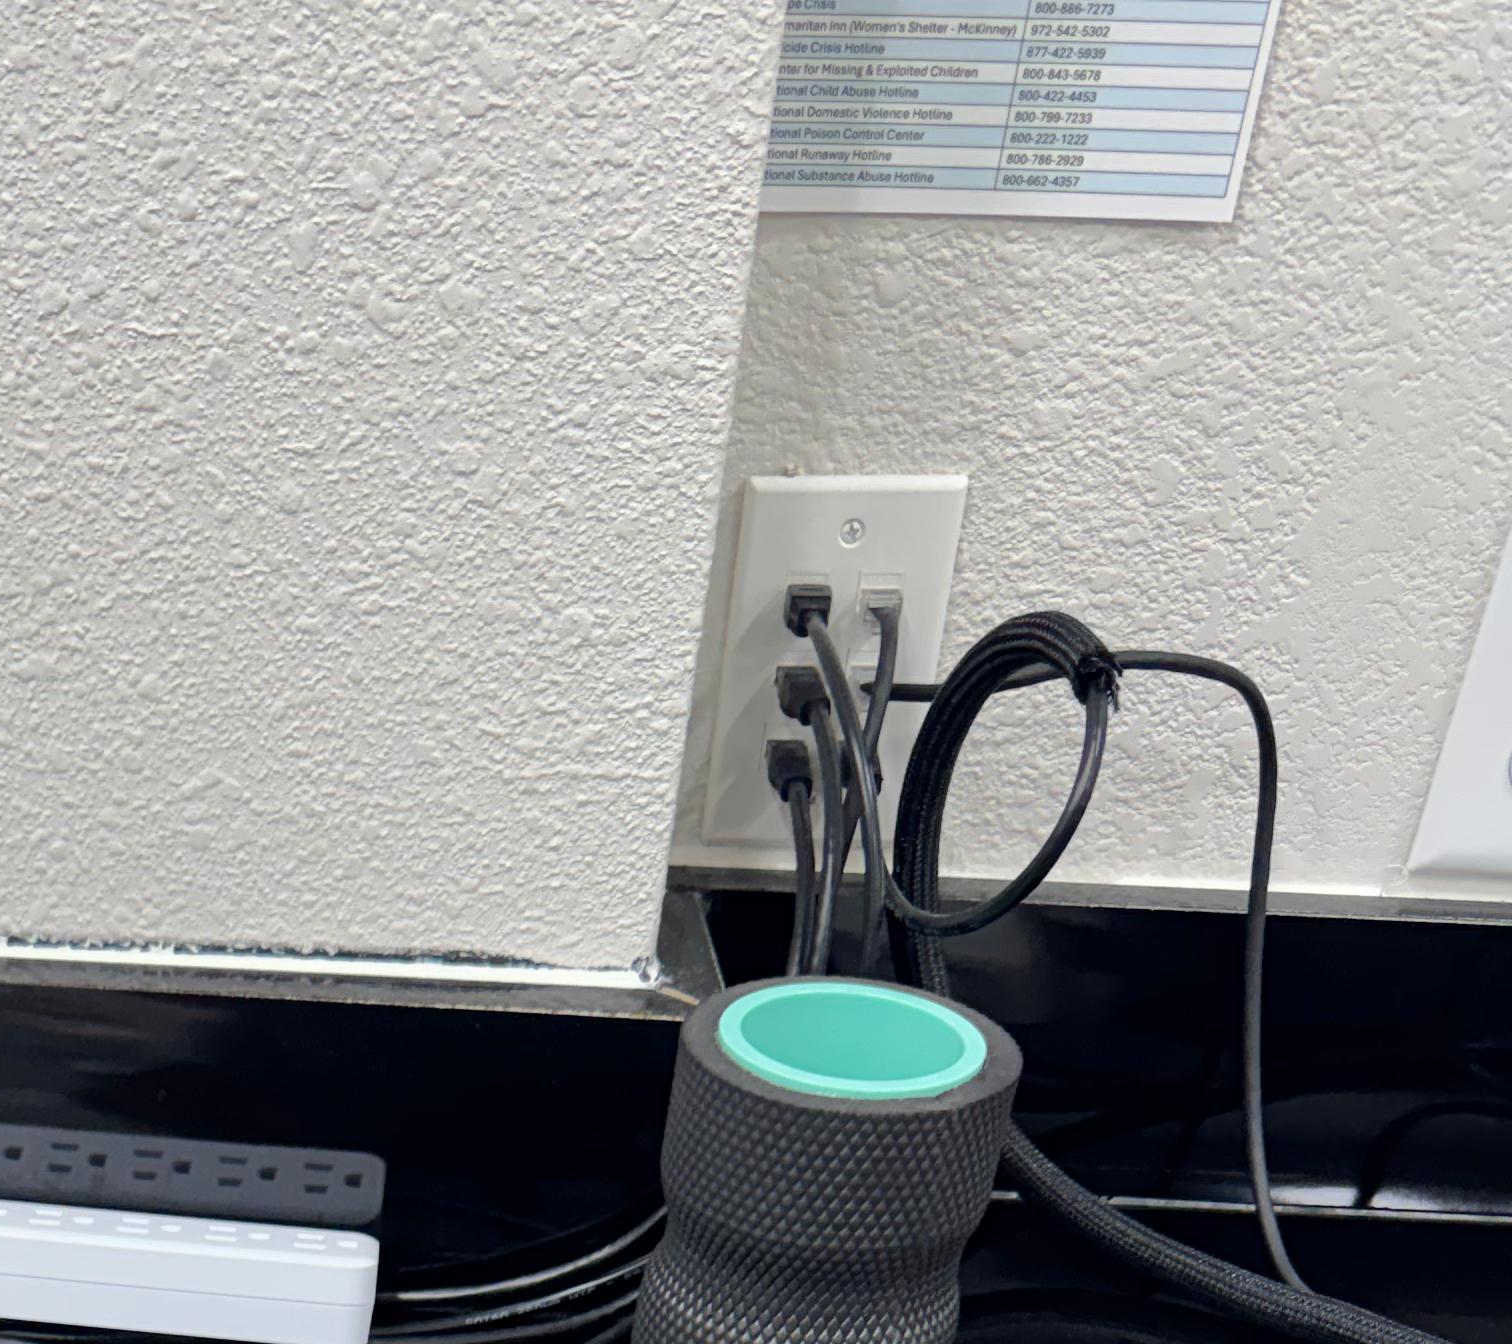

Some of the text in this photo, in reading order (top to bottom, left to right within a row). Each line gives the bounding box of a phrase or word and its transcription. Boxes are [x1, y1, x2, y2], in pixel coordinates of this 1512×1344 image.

[804, 0, 836, 10] Crisis
[849, 21, 906, 34] (Women's
[908, 21, 948, 34] Shelter
[957, 22, 1017, 37] McKinney)
[1031, 24, 1110, 38] 972-542-5302
[810, 42, 842, 54] Crisis
[844, 43, 885, 55] Hotline
[803, 64, 819, 75] for
[821, 64, 863, 78] Missing
[865, 64, 873, 76] &
[876, 64, 928, 78] Exploited
[930, 65, 978, 78] Children
[1022, 68, 1101, 81] 800-843-5678
[810, 85, 839, 97] Child
[841, 86, 876, 97] Abuse
[878, 86, 919, 98] Hotline
[1018, 89, 1097, 103] 800-422-4453
[807, 106, 859, 118] Domestic
[862, 107, 910, 119] Violence
[912, 108, 953, 120] Hotline
[1014, 111, 1093, 124] 800-799-7233
[803, 128, 840, 139] Poison
[843, 128, 885, 140] Control
[887, 129, 925, 141] Center
[1010, 132, 1088, 145] 800-222-1222
[800, 148, 850, 163] Runaway
[852, 149, 892, 161] Hotline
[1006, 153, 1084, 166] 800-786-2929
[798, 169, 856, 181] Substance
[857, 171, 891, 182] Abuse
[894, 172, 935, 183] Hotline
[1002, 174, 1080, 188] 800-662-4357
